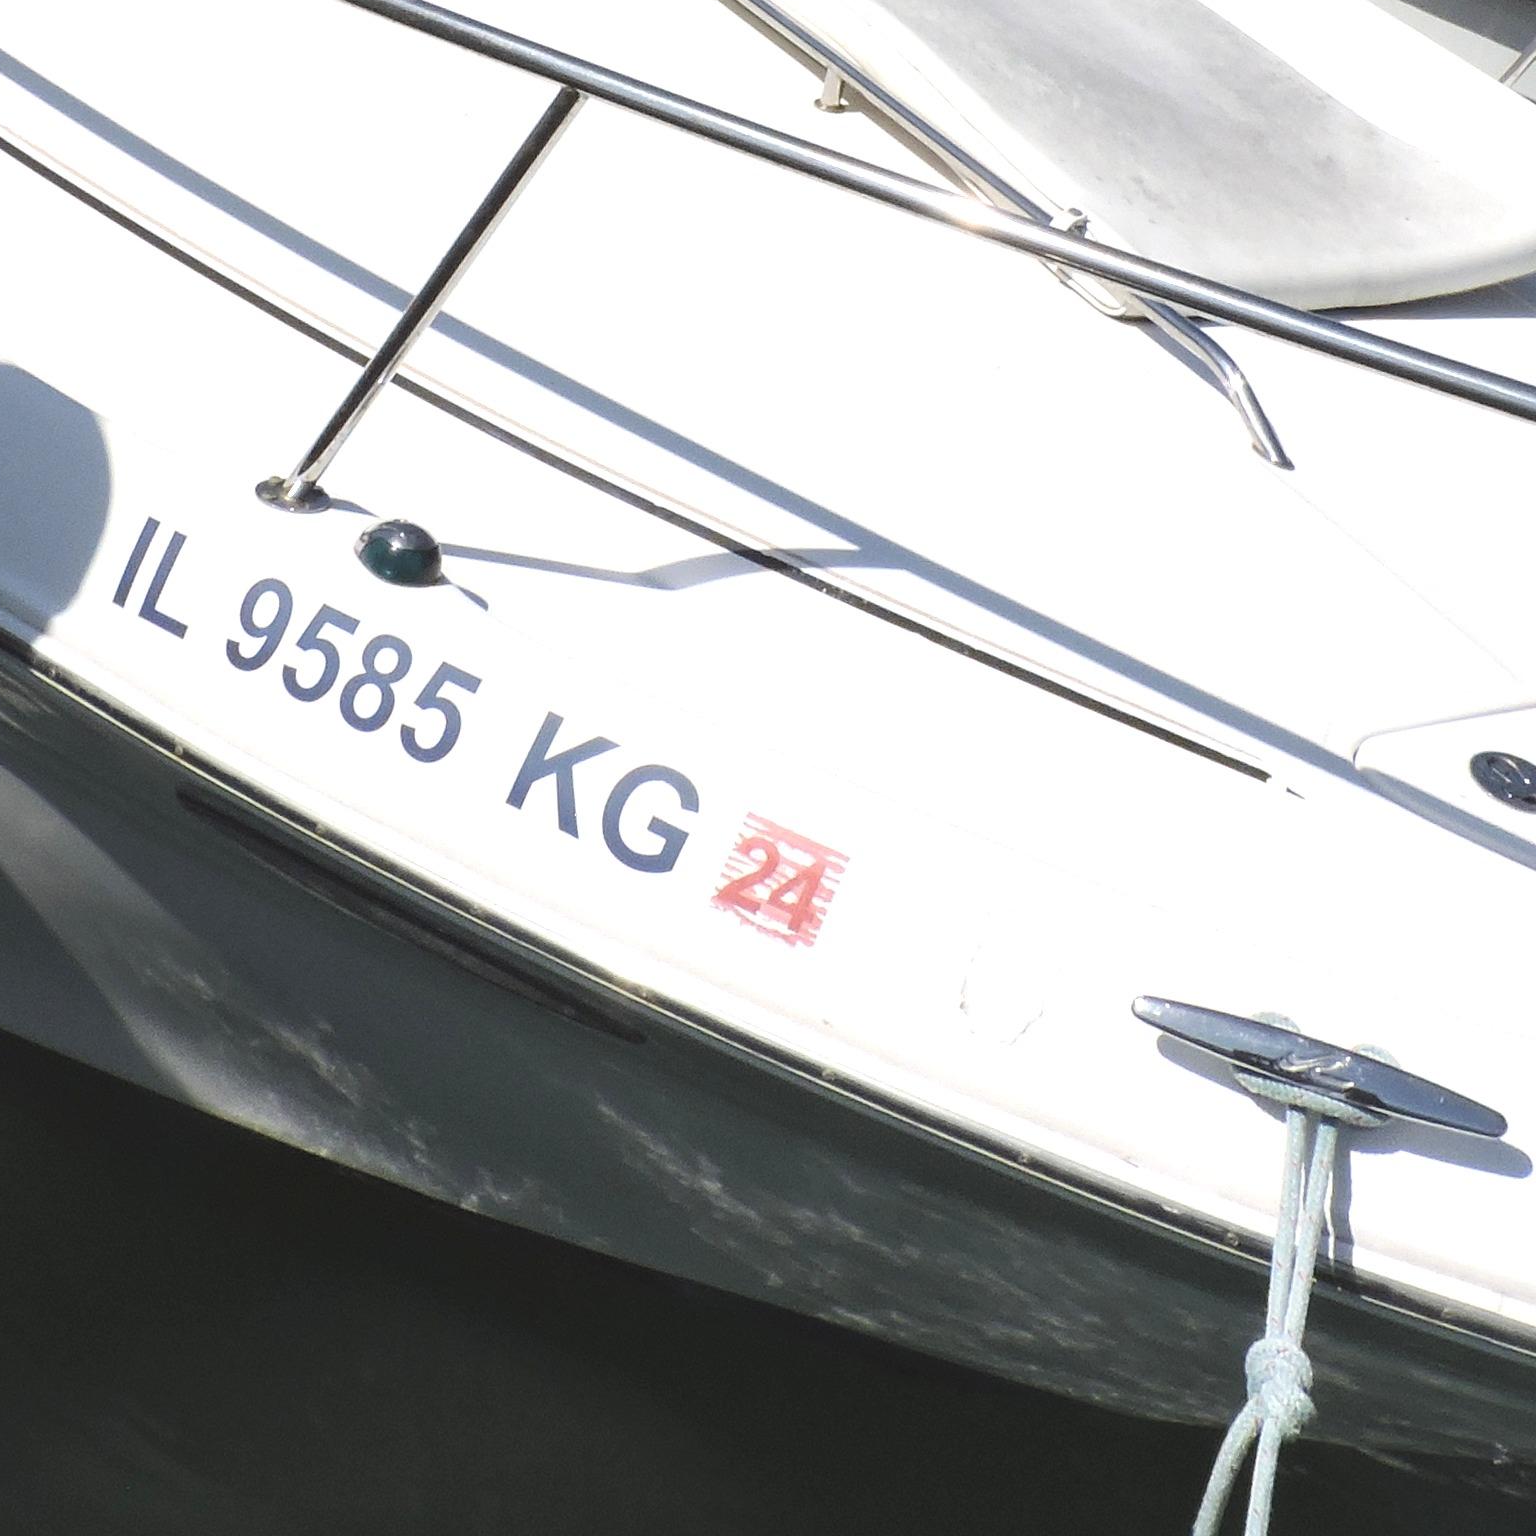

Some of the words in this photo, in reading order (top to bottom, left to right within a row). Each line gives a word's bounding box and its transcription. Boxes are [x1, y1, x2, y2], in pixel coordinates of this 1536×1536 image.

[112, 517, 189, 639] IL
[226, 577, 483, 763] 9585
[506, 712, 700, 873] KG
[717, 836, 826, 933] 24
